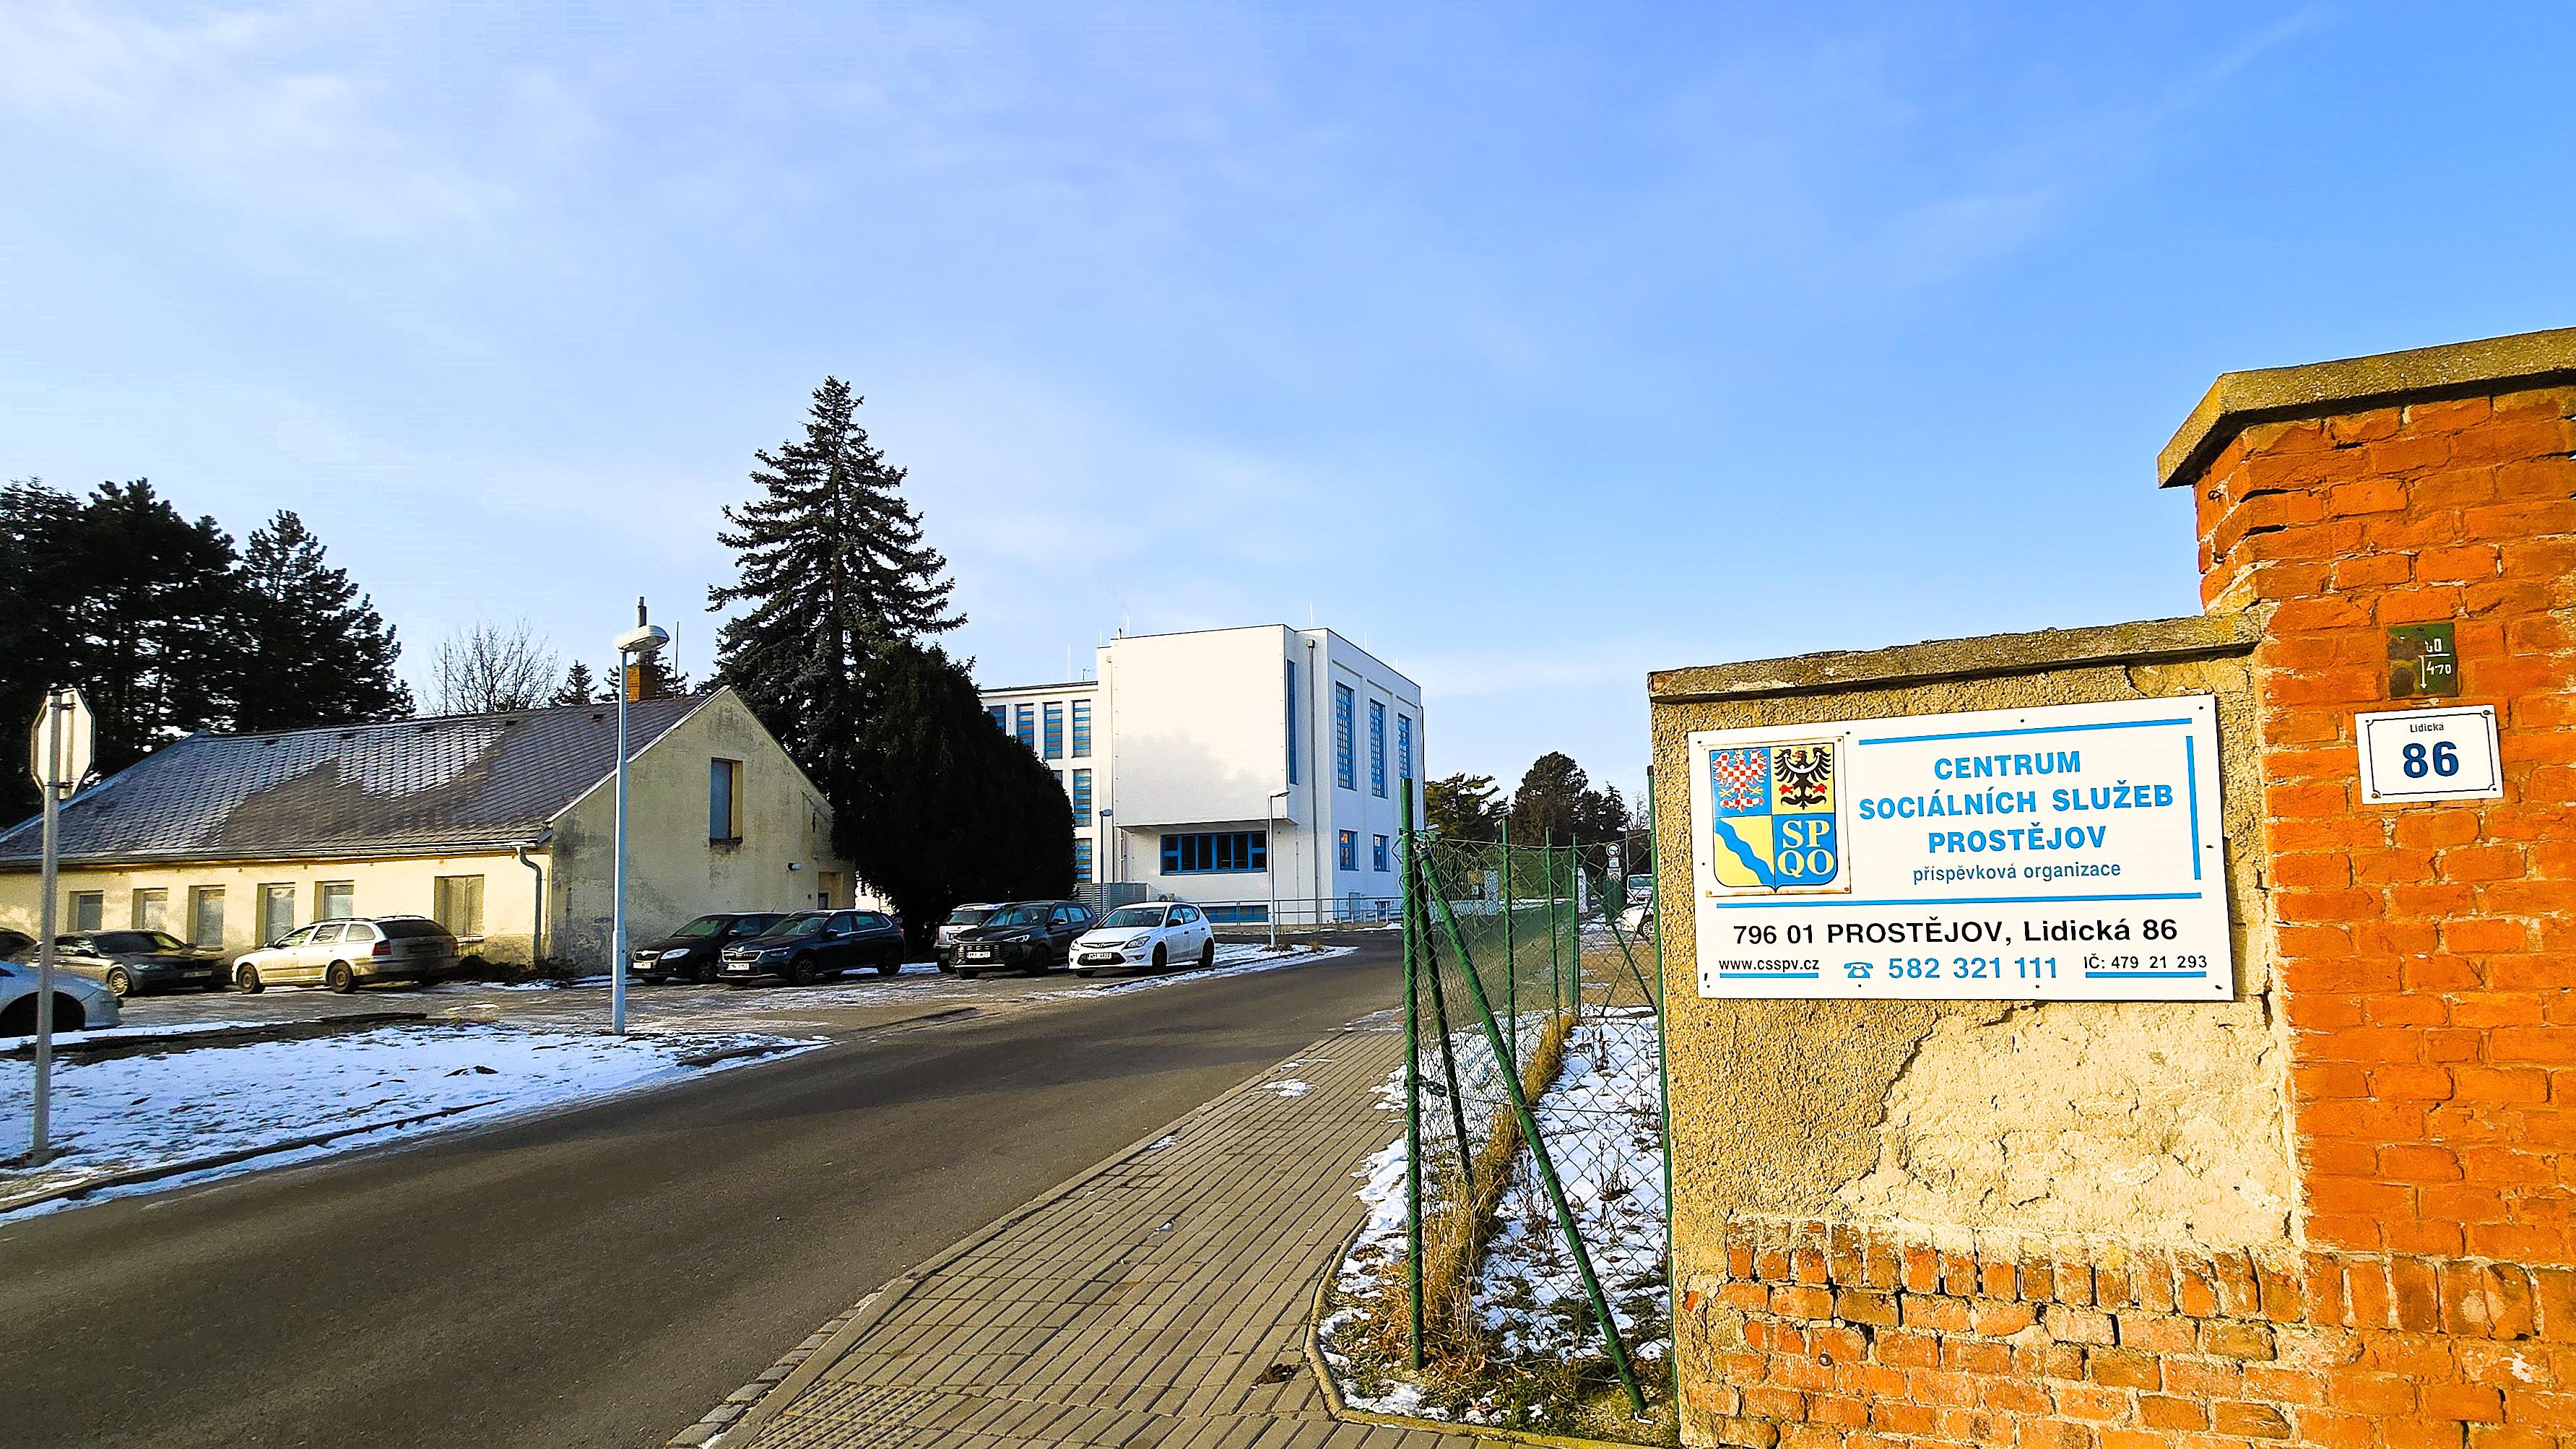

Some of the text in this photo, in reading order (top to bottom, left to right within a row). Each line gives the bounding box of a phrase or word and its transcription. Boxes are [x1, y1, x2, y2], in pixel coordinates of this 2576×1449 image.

[2409, 722, 2445, 732] Lidická
[1935, 751, 2081, 779] CENTRUM
[2403, 741, 2459, 778] 86
[1860, 780, 2173, 820] SOCIÁLNÍCH SLUŽEB
[1782, 820, 1830, 849] SP
[1929, 822, 2107, 853] PROSTĚJOV
[1777, 849, 1834, 878] QO
[1913, 862, 2121, 886] příspěvková organizace
[1734, 917, 2177, 946] 796 01 PROSTĚJOV, Lidická 86
[1719, 959, 1819, 972] www.csspv.cz
[1889, 957, 2057, 979] 582 321 111
[2084, 956, 2208, 969] IČ: 479 21 293
